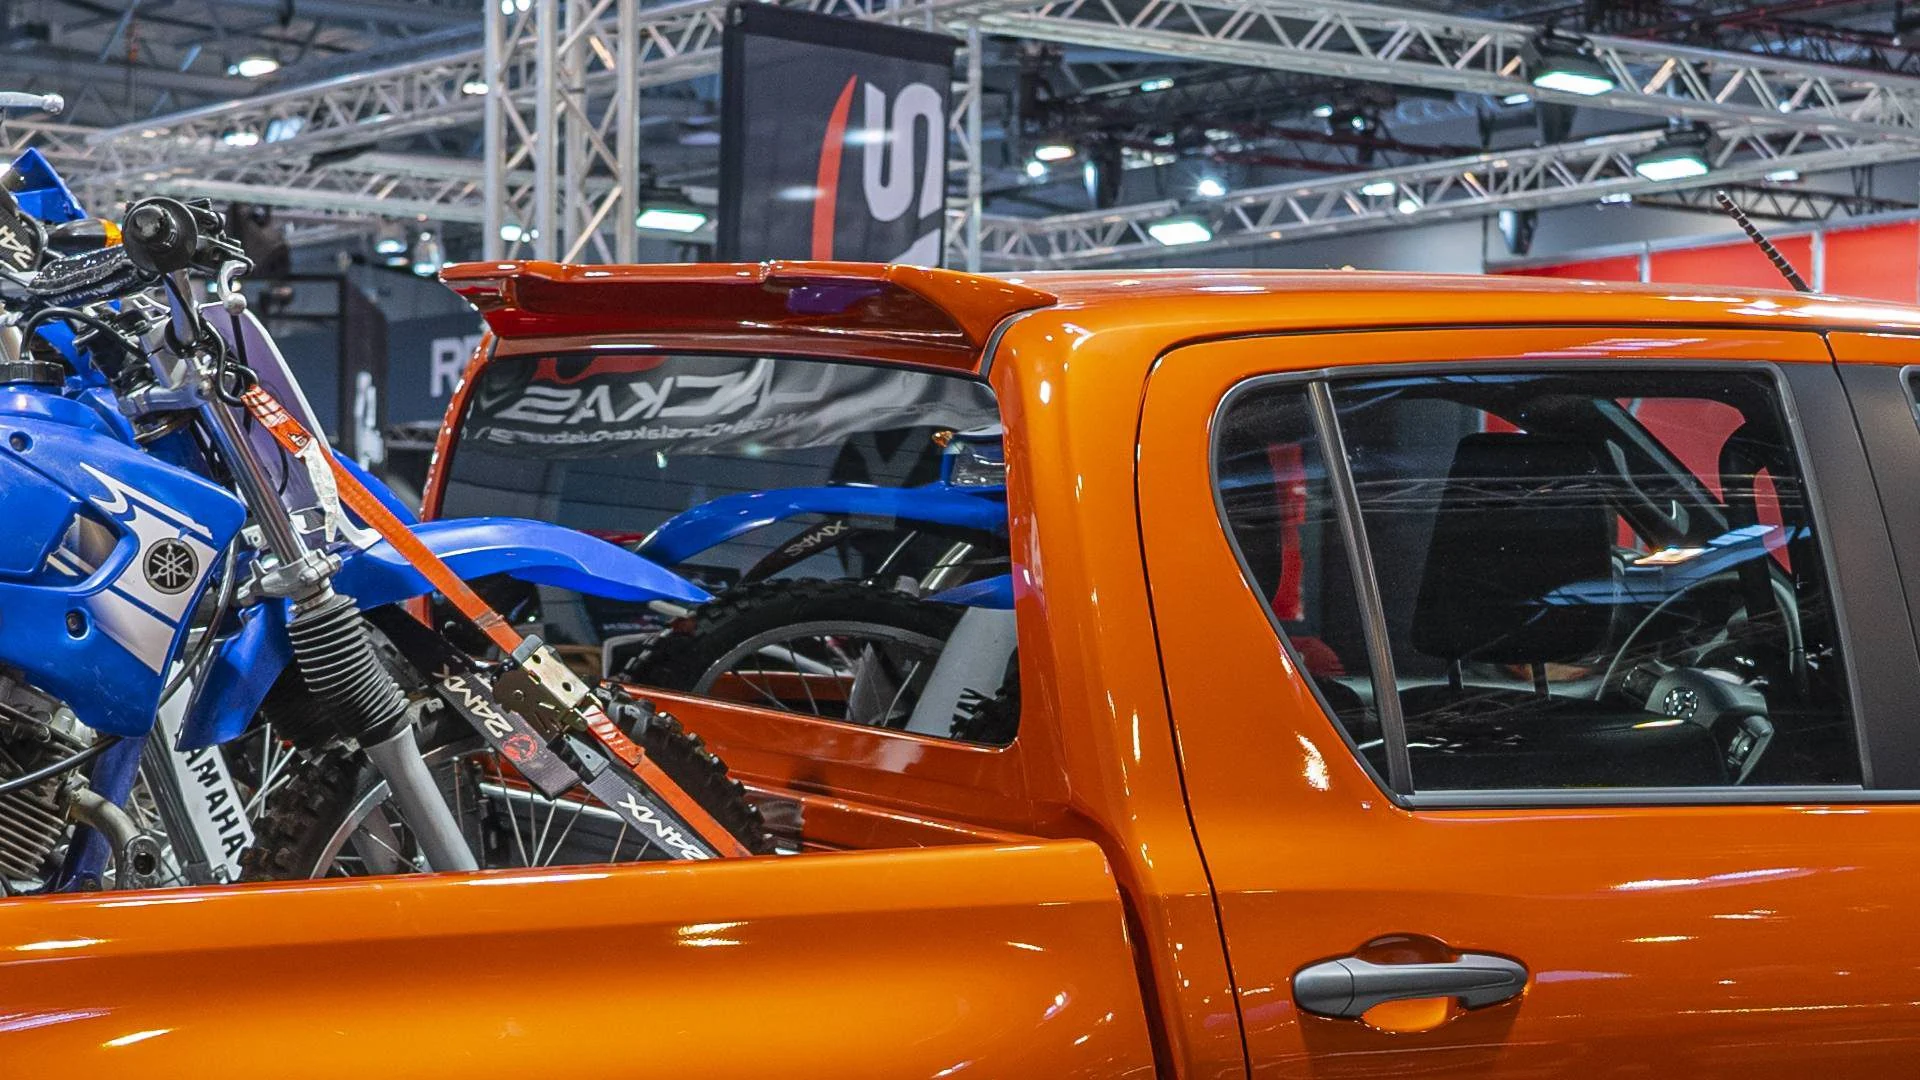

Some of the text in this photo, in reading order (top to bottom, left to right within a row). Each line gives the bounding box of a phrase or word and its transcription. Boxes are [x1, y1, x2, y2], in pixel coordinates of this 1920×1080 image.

[432, 663, 514, 739] 24MX
[184, 749, 247, 858] AMAHA
[617, 793, 710, 860] 24MX
